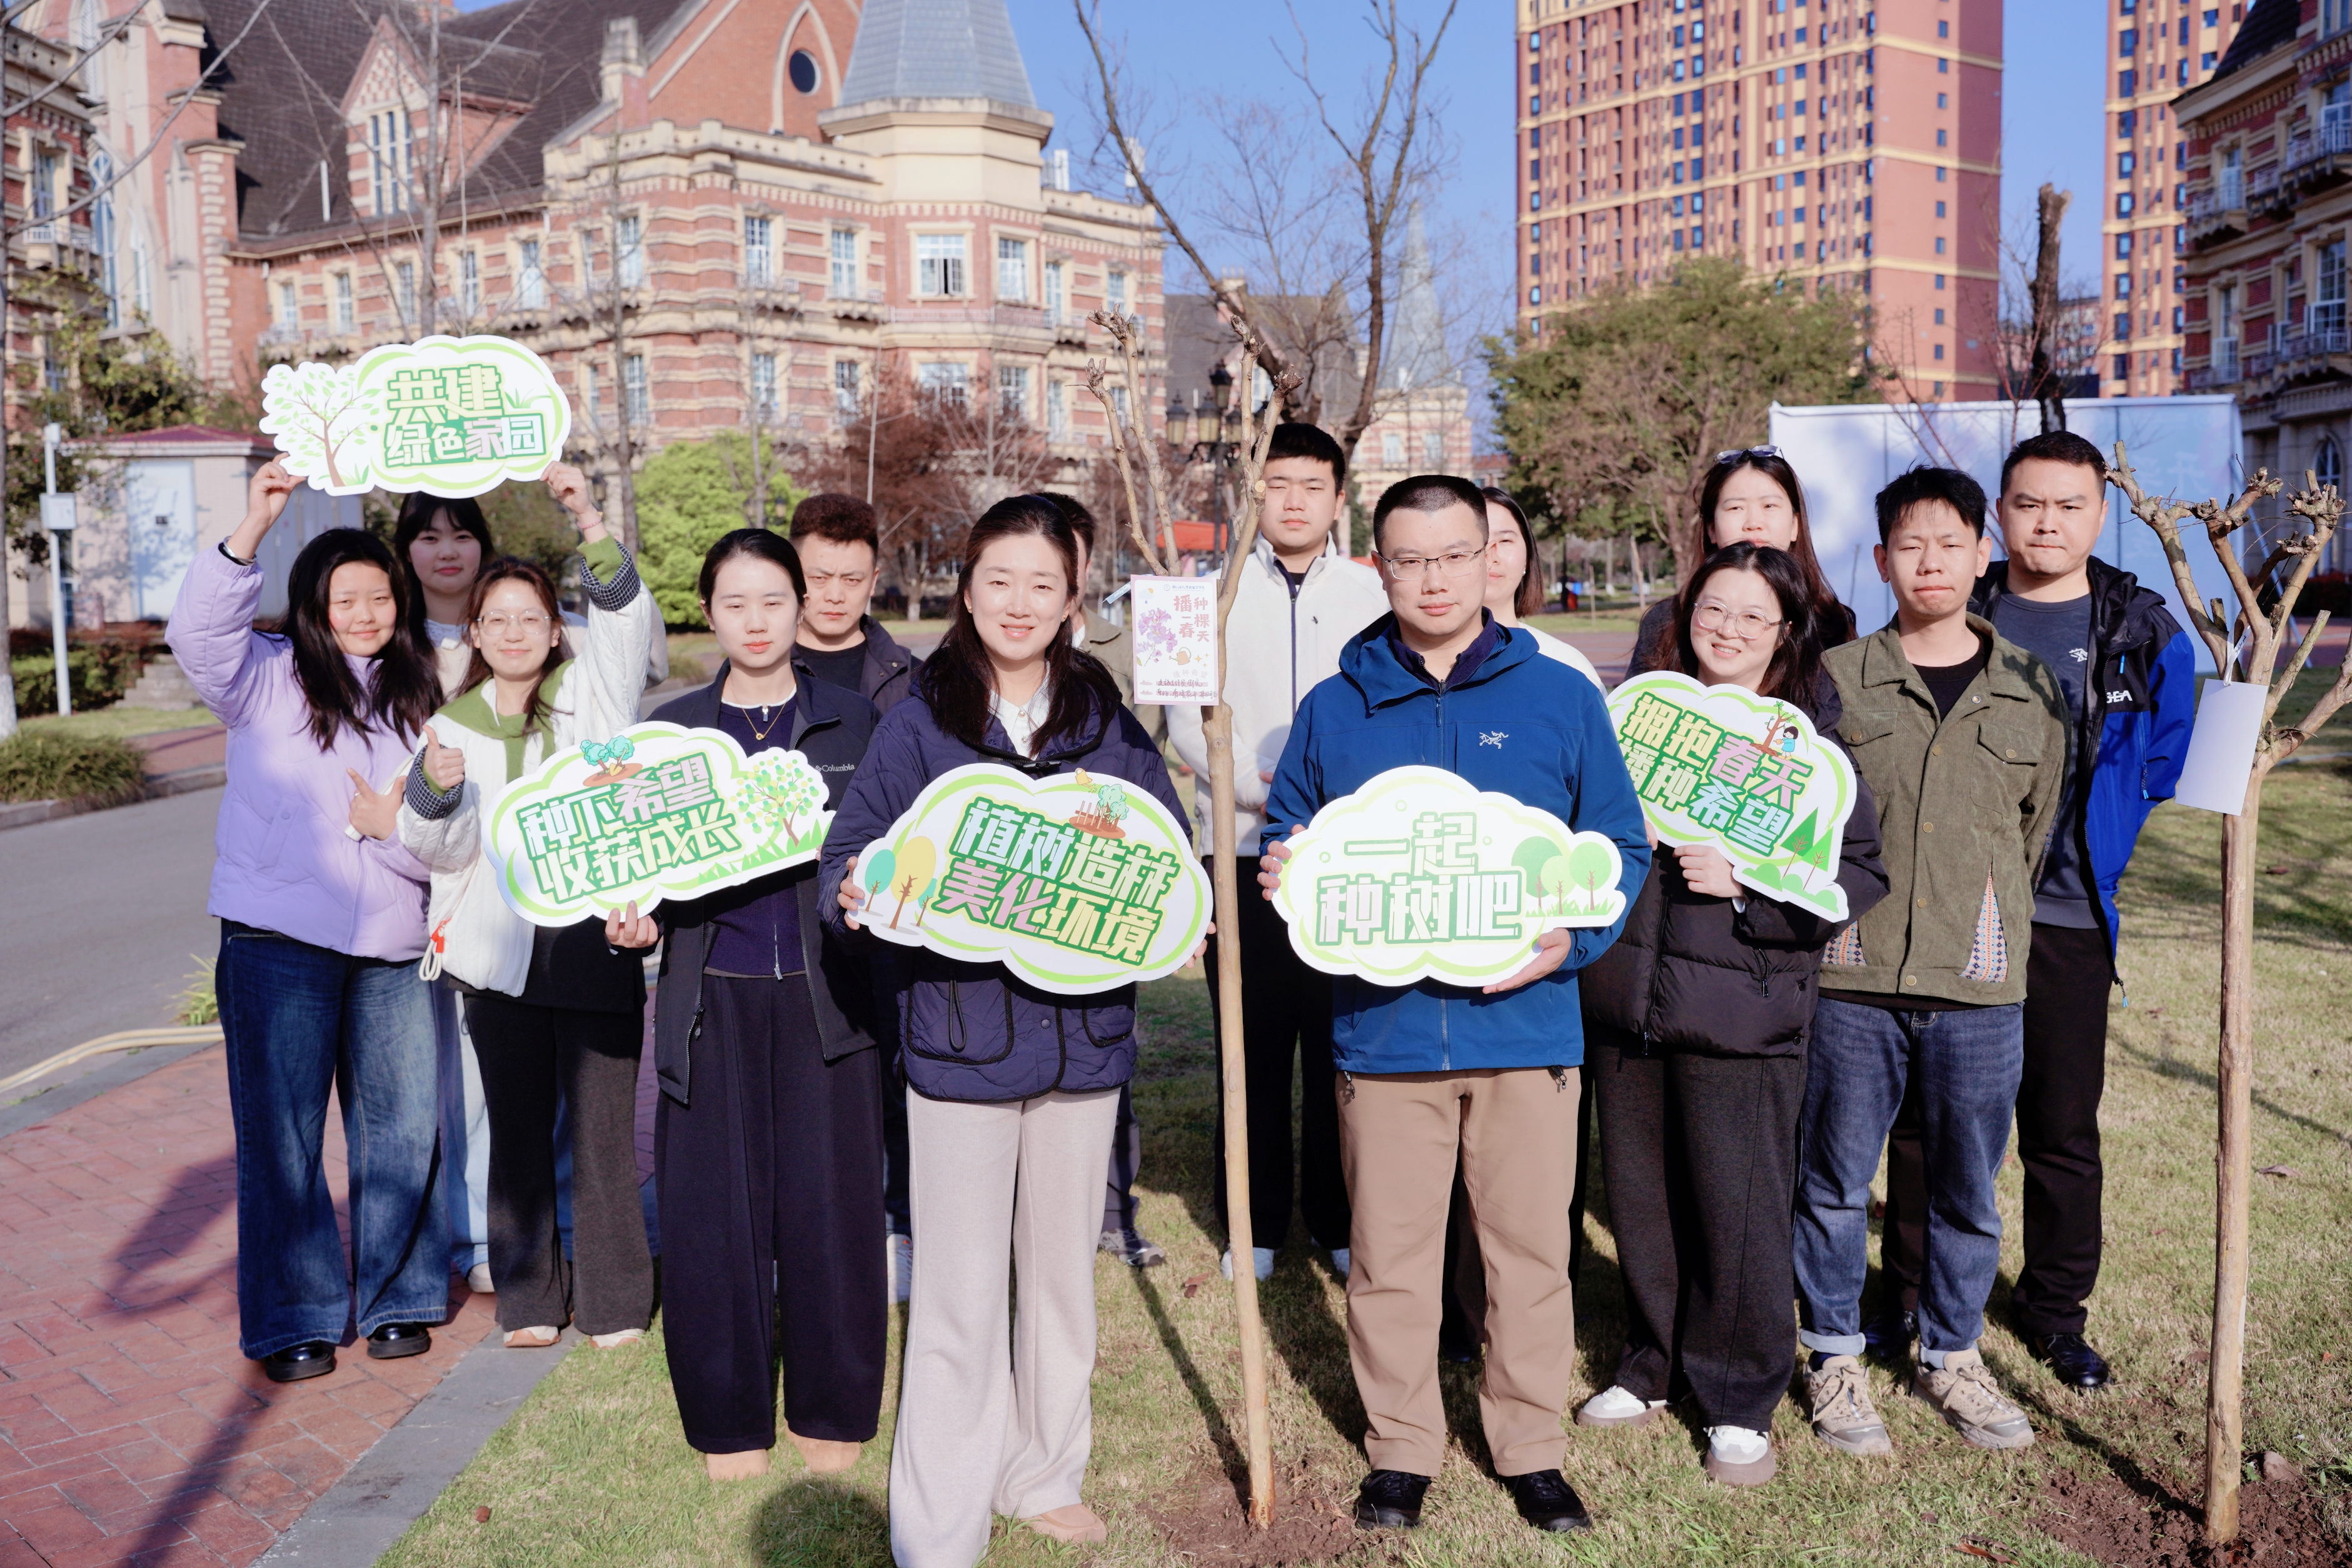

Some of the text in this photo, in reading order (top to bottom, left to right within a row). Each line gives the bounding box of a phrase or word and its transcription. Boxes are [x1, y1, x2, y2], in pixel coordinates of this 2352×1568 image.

[387, 364, 503, 424] 共建
[385, 413, 548, 467] 绿色家园
[1173, 669, 1208, 679] 播种希望
[822, 763, 855, 772] Columbia
[1621, 691, 1813, 809] 拥抱春天
[516, 753, 716, 859] 种下希望
[535, 799, 743, 903] 收获成长
[949, 797, 1180, 908] 植树造林
[1344, 812, 1478, 877] 一起
[932, 858, 1163, 966] 美化环境
[1315, 870, 1522, 945] 种树吧
